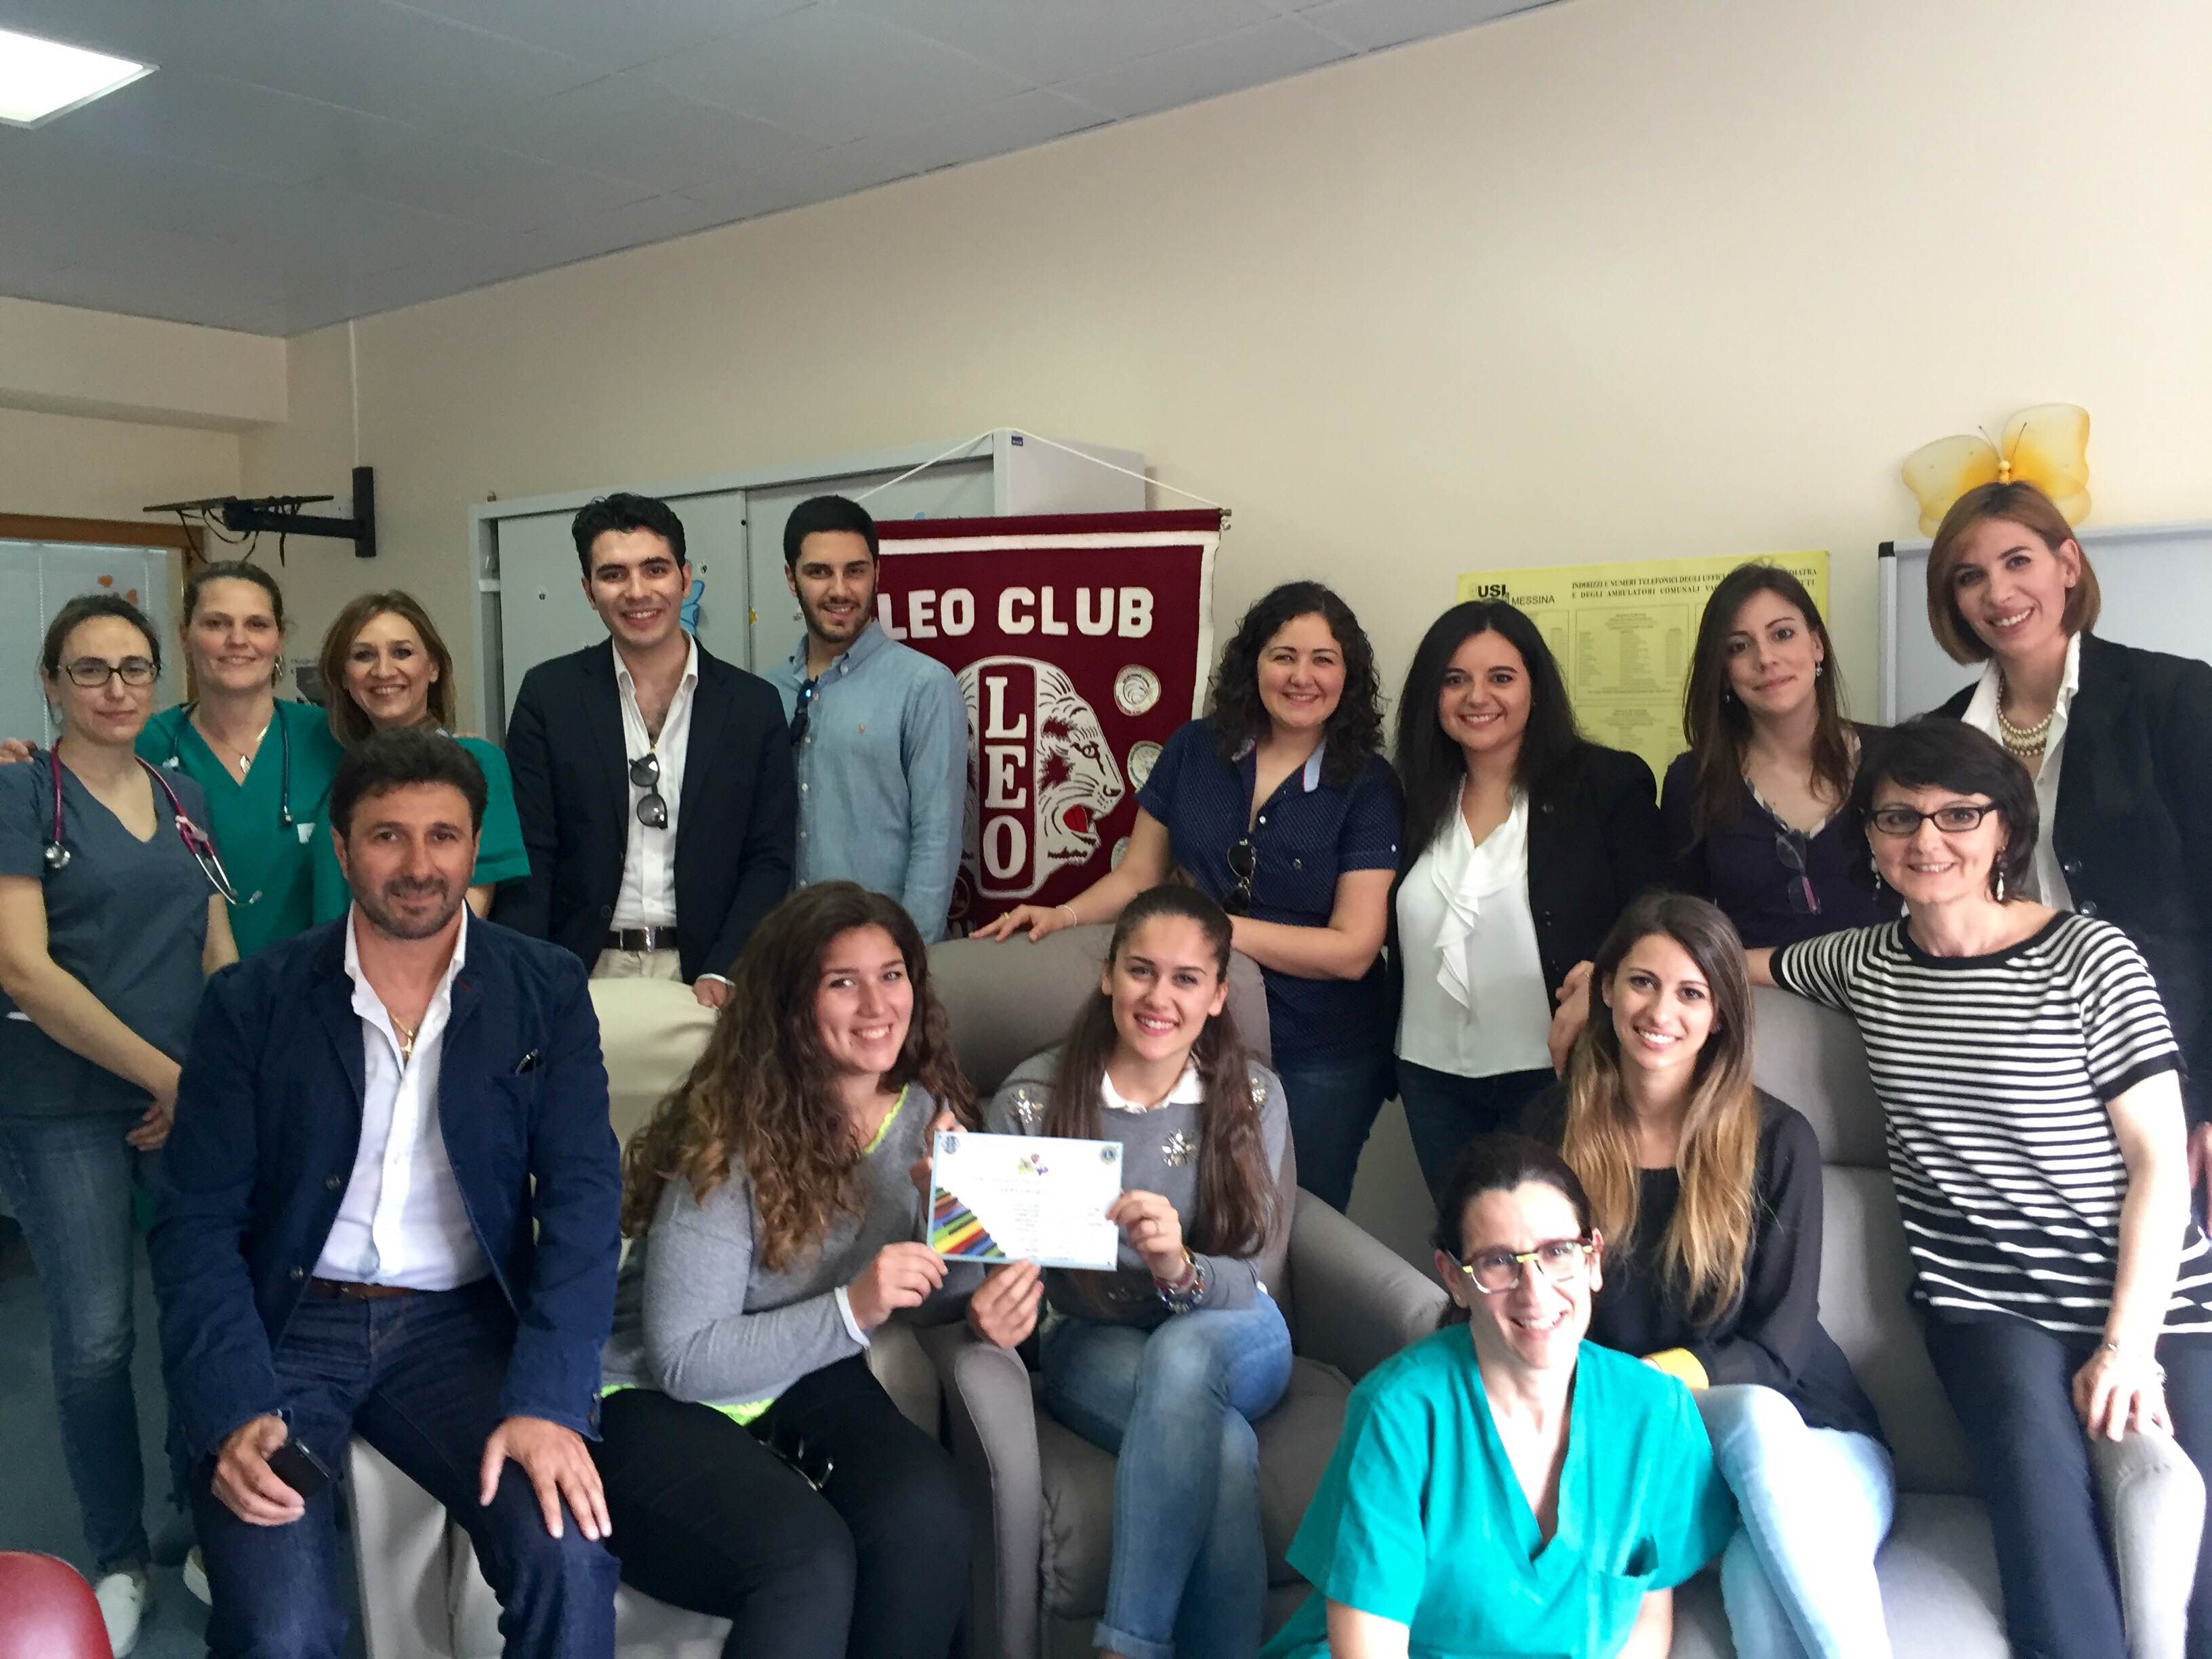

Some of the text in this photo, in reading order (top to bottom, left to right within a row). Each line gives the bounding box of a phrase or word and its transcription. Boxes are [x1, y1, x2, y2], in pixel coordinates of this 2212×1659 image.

[1639, 576, 1678, 585] TELEFONICI
[1608, 588, 1655, 596] AMBULATORI
[1660, 586, 1700, 594] COMUNALI
[1511, 595, 1555, 606] MESSINA
[877, 586, 1154, 641] LEO CLUB
[983, 676, 1027, 879] LEO
